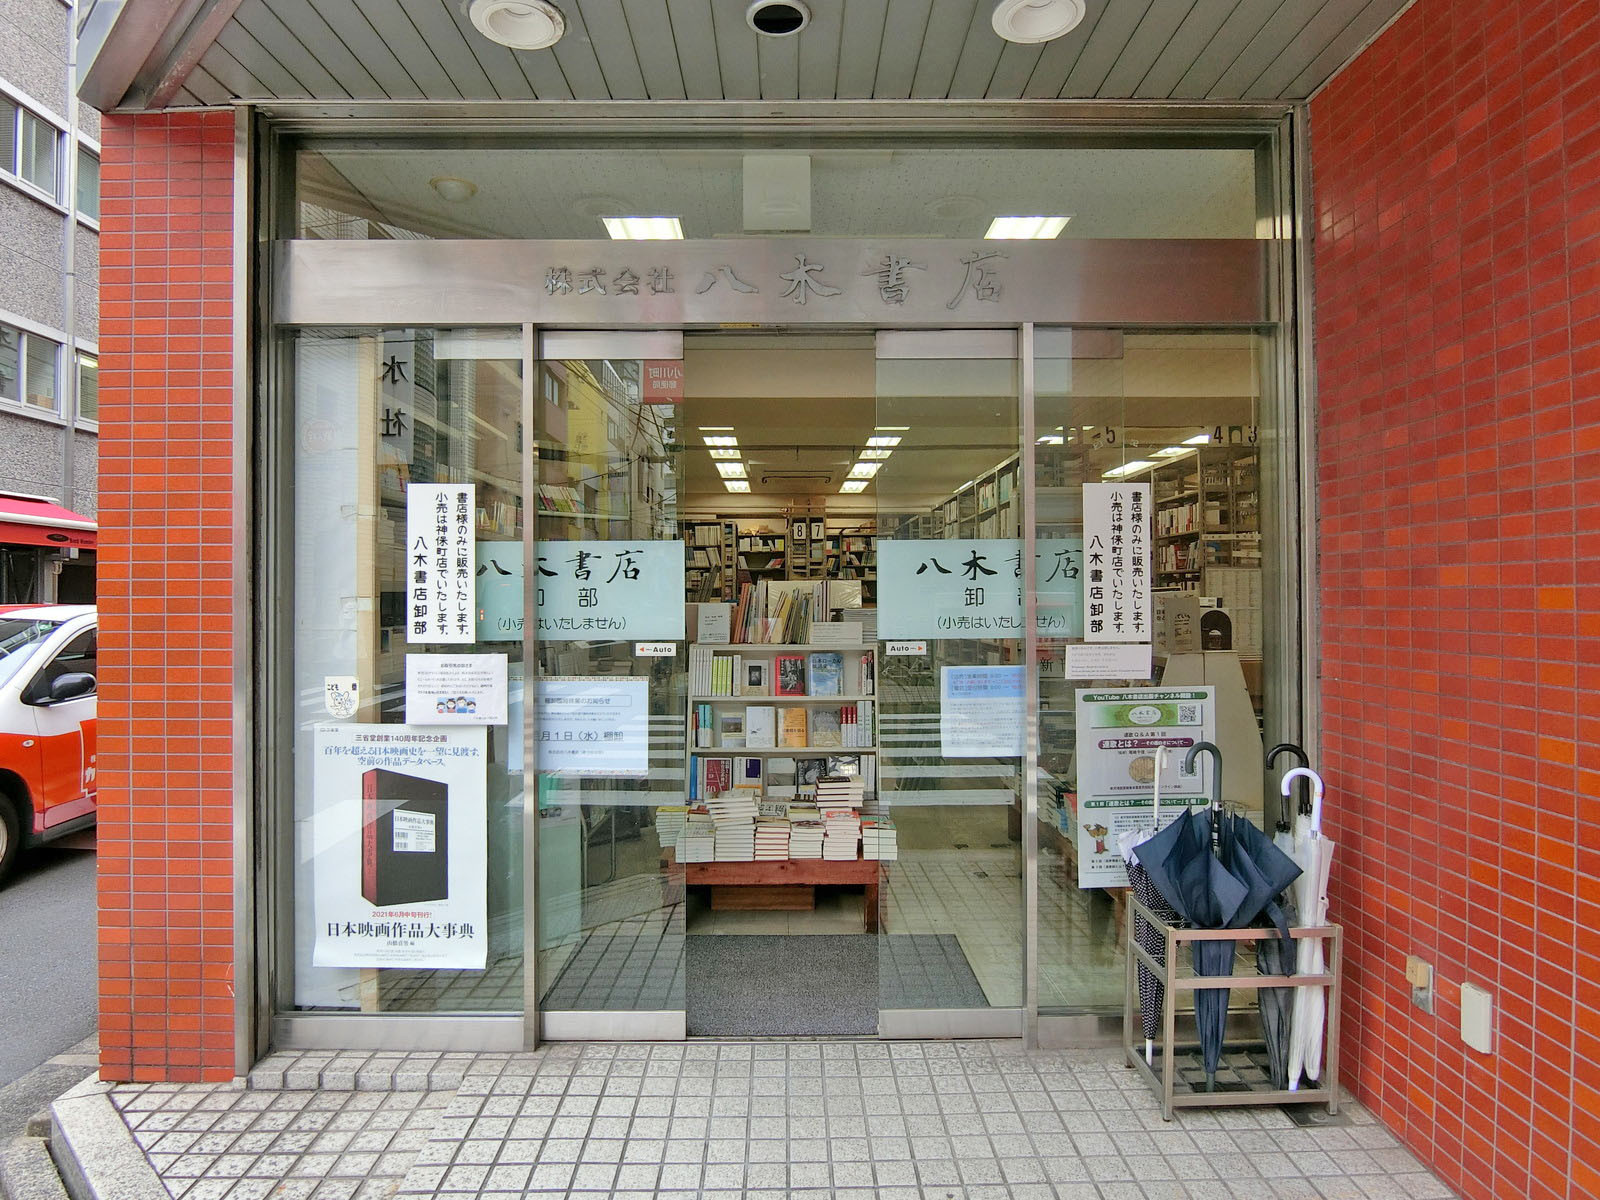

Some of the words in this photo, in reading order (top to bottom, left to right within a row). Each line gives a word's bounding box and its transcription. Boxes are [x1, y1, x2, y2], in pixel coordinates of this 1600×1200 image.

[543, 265, 676, 297] 株式会社
[695, 251, 1010, 311] 八木書店
[1213, 426, 1223, 443] 4
[797, 525, 804, 537] 8
[814, 524, 822, 537] 7
[412, 536, 429, 636] 八木書店卸部
[1089, 535, 1105, 634] 八木書店卸部
[652, 646, 673, 654] Auto
[890, 645, 911, 653] Auto
[355, 734, 448, 743] 三省堂創業140周年記念企画
[327, 921, 475, 939] 日本映画作品大事典
